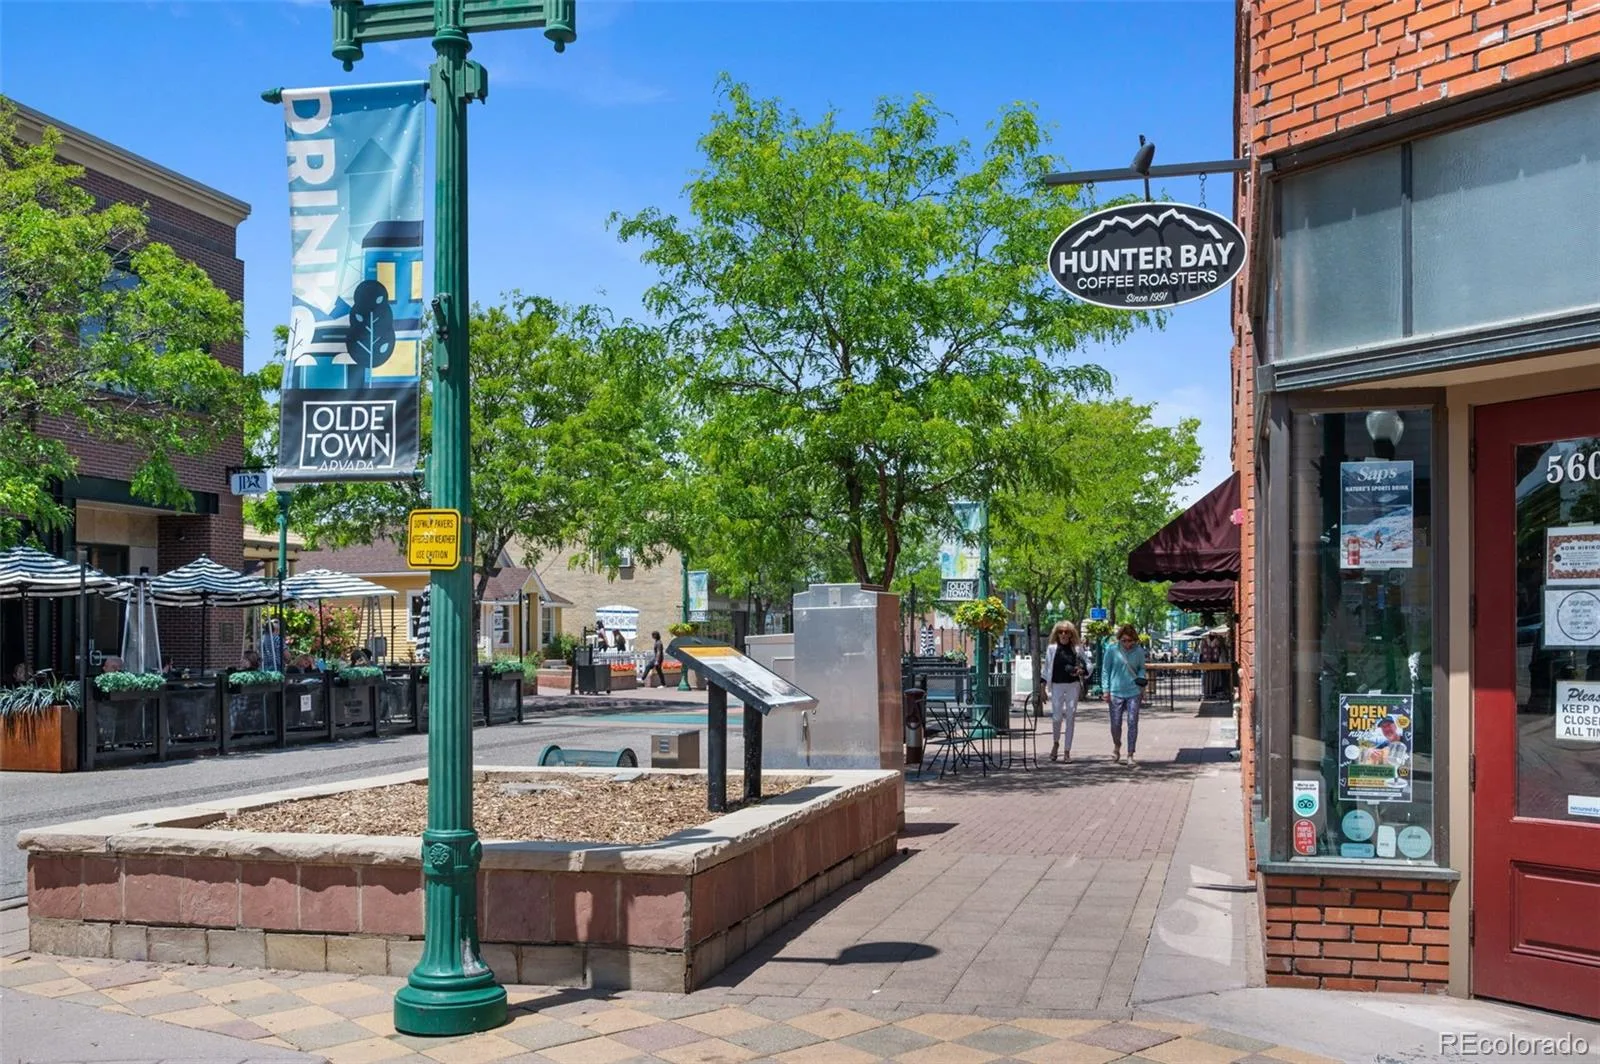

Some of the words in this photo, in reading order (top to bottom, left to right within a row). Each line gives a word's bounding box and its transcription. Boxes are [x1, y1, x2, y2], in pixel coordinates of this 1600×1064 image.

[282, 86, 340, 316] DRINK
[1059, 245, 1173, 274] HUNTER
[1180, 241, 1236, 268] BAY
[1077, 274, 1134, 290] COFFEE
[1138, 270, 1218, 287] ROASTERS
[1125, 292, 1149, 303] Since
[1150, 292, 1168, 302] 1991
[312, 406, 386, 431] OLDE
[306, 432, 390, 458] TOWN
[1357, 465, 1398, 484] Saps
[950, 582, 971, 590] OLDE
[948, 590, 971, 598] TOWN
[1349, 705, 1388, 718] OPEN
[1562, 703, 1590, 714] KEEP
[1349, 717, 1377, 731] MIC
[1563, 715, 1600, 726] CLOSE
[1564, 726, 1584, 737] ALL
